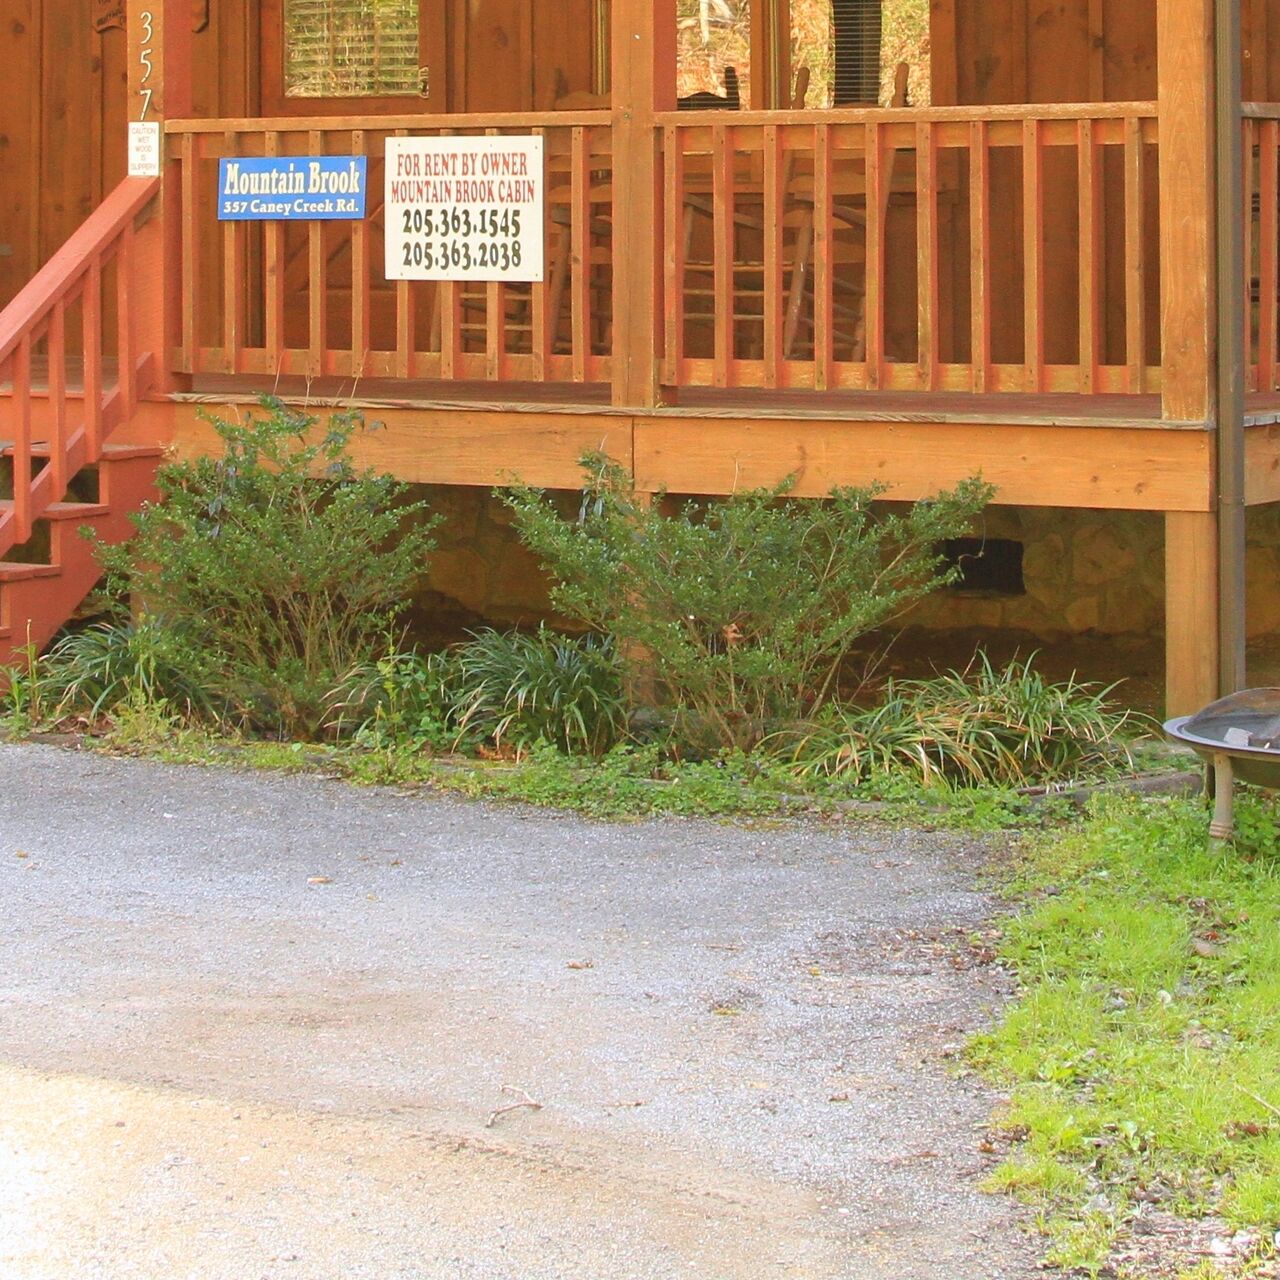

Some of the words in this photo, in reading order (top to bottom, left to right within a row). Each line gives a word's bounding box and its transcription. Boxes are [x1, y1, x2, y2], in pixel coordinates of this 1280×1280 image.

[139, 11, 153, 121] 357
[131, 127, 157, 135] CAUTION
[224, 163, 305, 195] Mountain
[308, 161, 360, 194] Brook
[397, 153, 421, 177] FOR
[424, 153, 458, 176] RENT
[461, 153, 478, 176] BY
[481, 152, 528, 176] OWNER
[391, 180, 452, 204] MOUNTAIN
[455, 180, 495, 204] BROOK
[498, 180, 535, 204] CABIN
[223, 201, 248, 213] 357
[250, 199, 292, 216] Caney
[293, 199, 333, 213] Creek
[336, 198, 359, 212] Rd.
[402, 206, 521, 238] 205.363.1545
[402, 239, 522, 271] 205.363.2038
